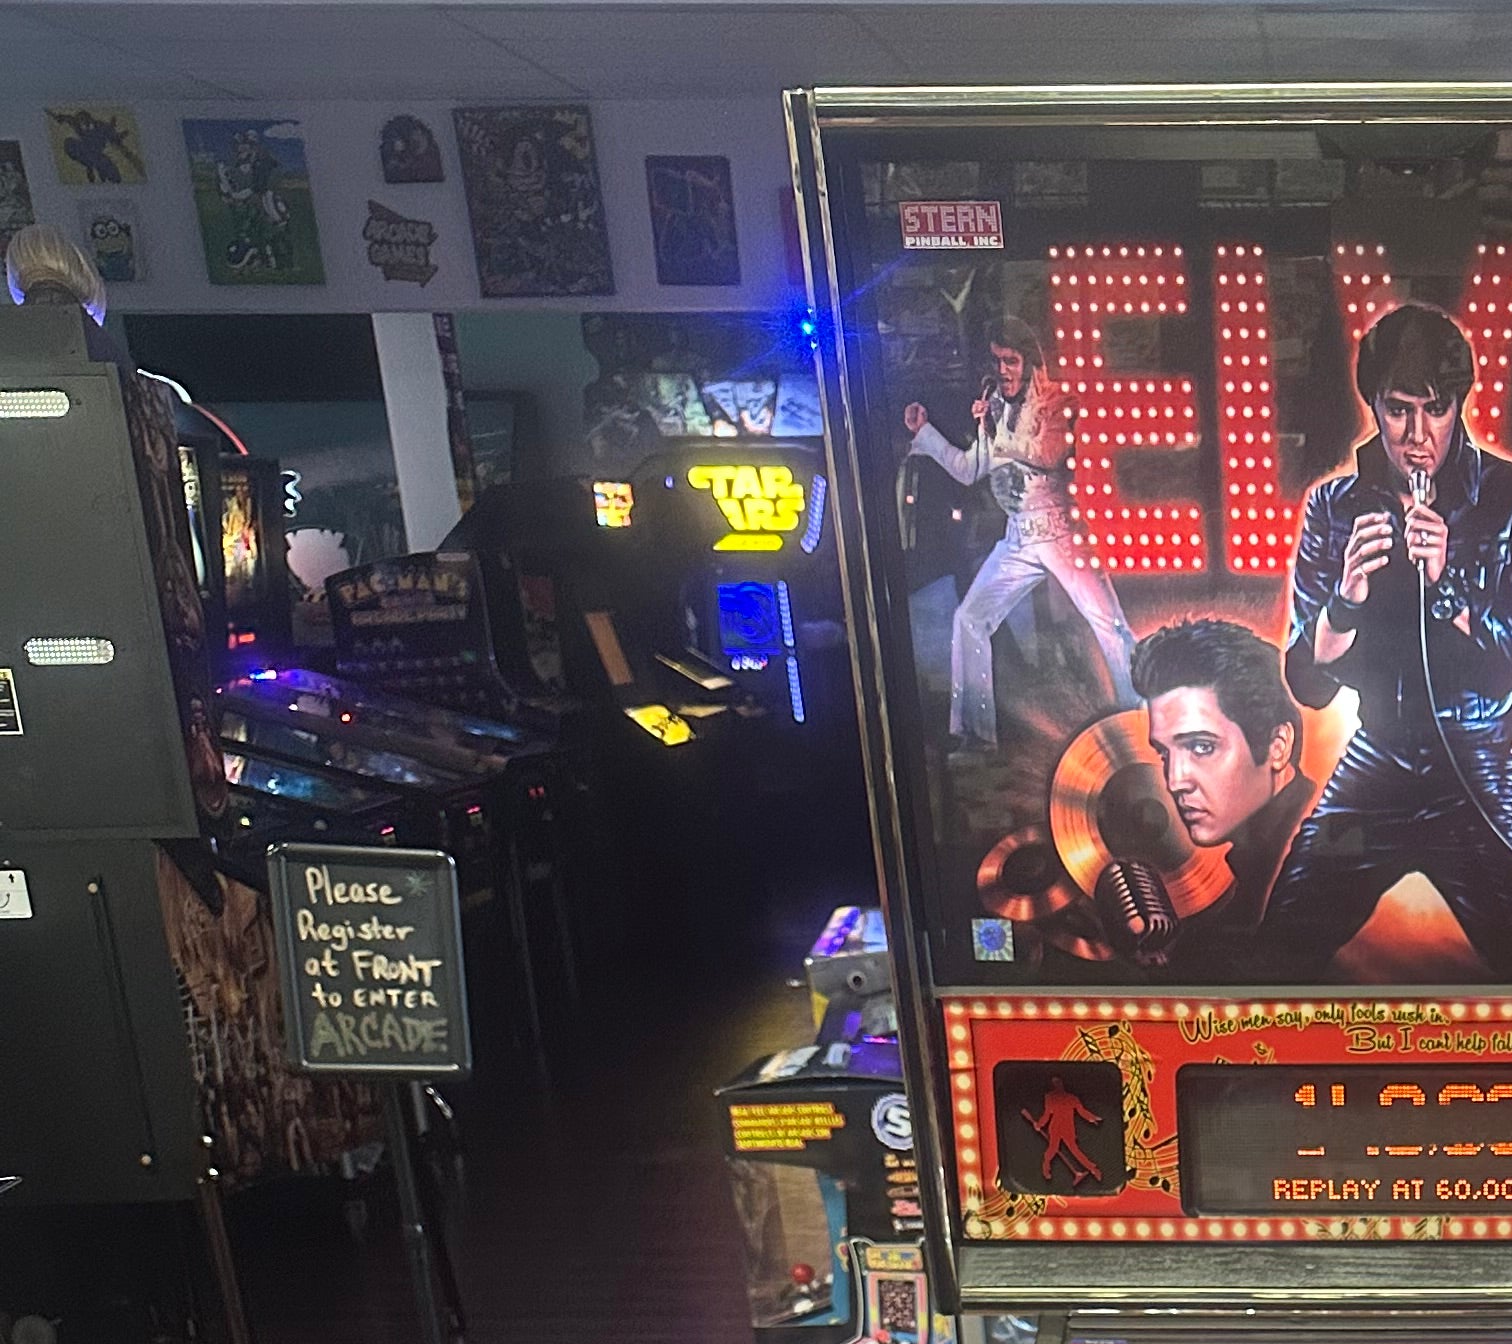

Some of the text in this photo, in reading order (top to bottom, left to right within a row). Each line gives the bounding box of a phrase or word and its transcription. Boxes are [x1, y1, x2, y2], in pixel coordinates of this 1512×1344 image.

[905, 205, 998, 232] STERN
[305, 864, 402, 905] Please
[297, 908, 415, 951] Register
[305, 949, 443, 987] at FRONT
[311, 982, 439, 1008] to ENTER
[310, 1011, 448, 1058] ARCADE
[1179, 1011, 1236, 1044] Wise
[1240, 1012, 1273, 1030] men
[1276, 1009, 1310, 1030] say,
[1314, 1005, 1346, 1028] only
[1350, 1003, 1385, 1022] fools
[1429, 1006, 1451, 1025] in.
[1346, 1026, 1395, 1053] But
[1398, 1026, 1413, 1052] I
[1456, 1032, 1487, 1056] help
[1273, 1178, 1381, 1200] REPLAY
[1392, 1178, 1424, 1199] AT
